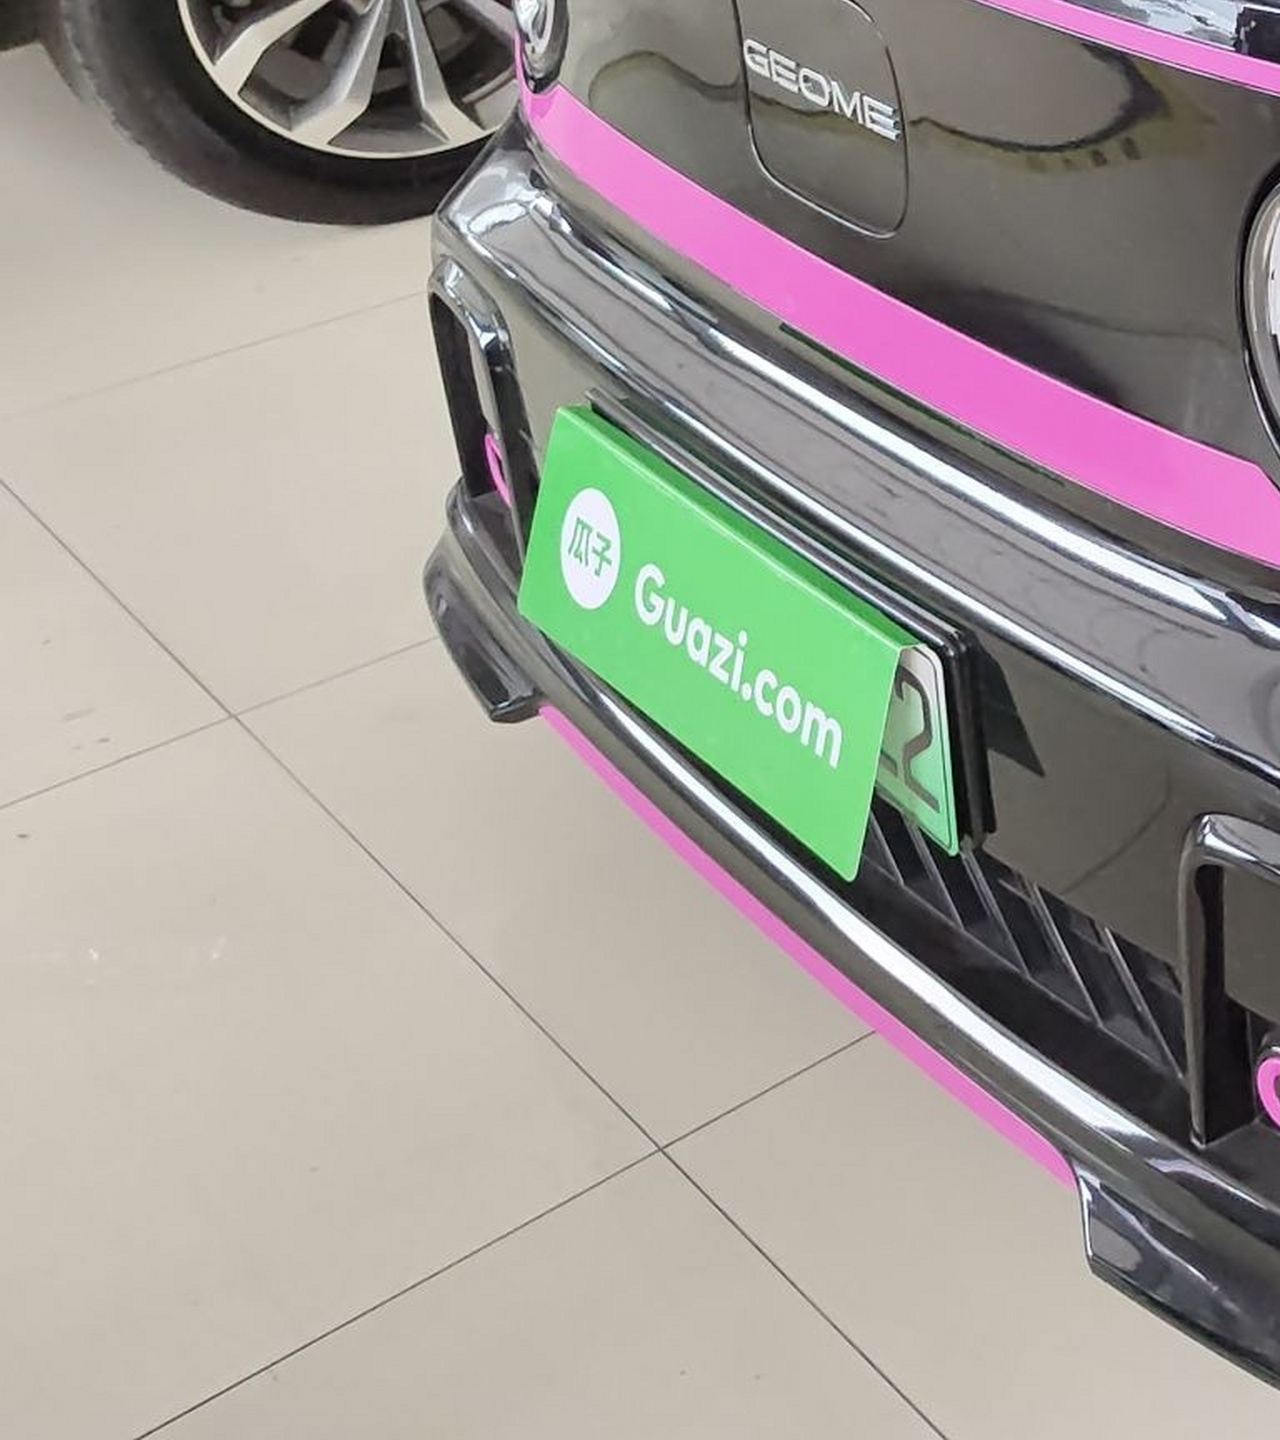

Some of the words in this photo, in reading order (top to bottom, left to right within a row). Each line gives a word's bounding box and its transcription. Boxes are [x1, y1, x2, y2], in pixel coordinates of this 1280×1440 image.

[743, 38, 902, 142] GEOME
[568, 517, 612, 577] 瓜子
[634, 561, 842, 768] Guazi.com
[880, 664, 941, 814] 2
